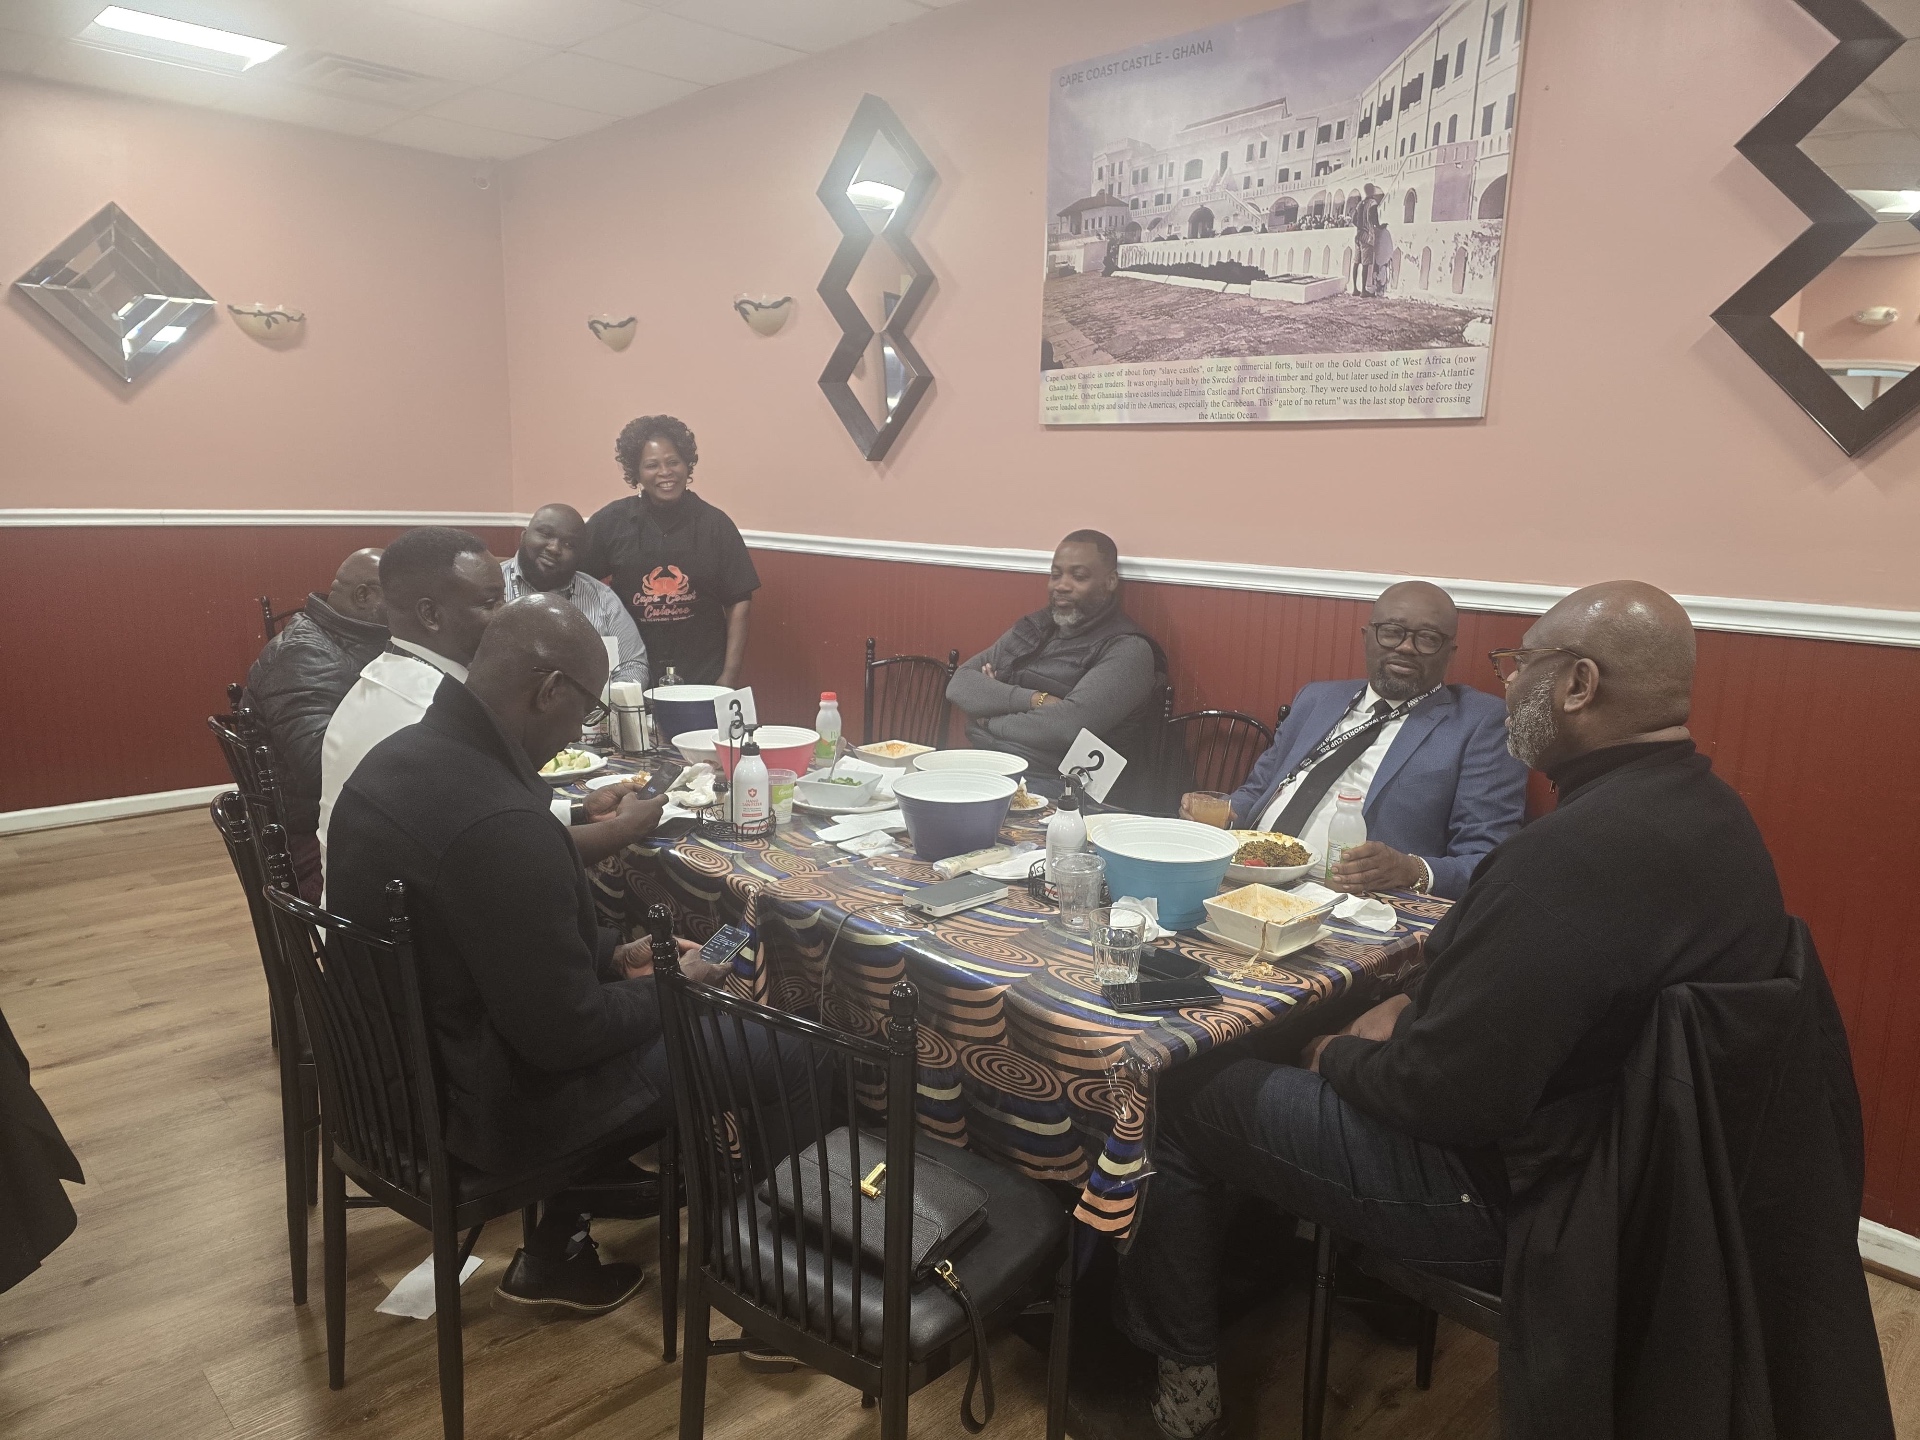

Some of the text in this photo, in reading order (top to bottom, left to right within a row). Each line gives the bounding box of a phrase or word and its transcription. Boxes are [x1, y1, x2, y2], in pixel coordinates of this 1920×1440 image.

[1059, 71, 1084, 88] CAPE
[1086, 62, 1120, 81] COAST
[1121, 51, 1162, 73] CASTLE
[1172, 39, 1214, 61] GHANA
[1045, 375, 1059, 383] Cape
[1078, 372, 1095, 380] Castle
[1142, 368, 1155, 376] forty
[1216, 364, 1231, 373] large
[1234, 361, 1272, 371] commercial
[1274, 361, 1292, 370] forts,
[1296, 360, 1313, 369] built
[1327, 360, 1339, 368] the
[1342, 359, 1361, 368] Gold
[1365, 358, 1386, 367] Coast
[1390, 358, 1400, 366] of
[1402, 357, 1421, 365] West
[1425, 355, 1451, 365] Africa
[1454, 355, 1476, 365] (now
[1146, 378, 1173, 388] originally
[1176, 377, 1190, 385] built
[1191, 377, 1198, 386] by
[1200, 376, 1210, 384] the
[1212, 375, 1235, 383] Swedes
[1237, 374, 1247, 383] for
[1249, 374, 1265, 382] trade
[1267, 374, 1274, 382] in
[1276, 373, 1298, 381] timber
[1300, 372, 1312, 381] and
[1315, 372, 1334, 382] gold,
[1336, 372, 1348, 380] but
[1351, 371, 1368, 380] later
[1370, 371, 1388, 380] used
[1391, 371, 1398, 379] in
[1402, 370, 1414, 379] the
[1416, 368, 1474, 378] trans-Atlantic
[1081, 392, 1096, 400] Other
[1097, 391, 1123, 399] Ghanaian
[1160, 389, 1182, 397] include
[1184, 388, 1205, 396] Elmina
[1207, 388, 1226, 396] Castle
[1228, 387, 1239, 395] and
[1241, 387, 1254, 395] Fort
[1256, 385, 1307, 395] Christiansborg.
[1310, 385, 1327, 394] They
[1350, 384, 1367, 392] used
[1380, 384, 1396, 392] hold
[1399, 383, 1423, 391] slaves
[1426, 382, 1452, 390] before
[1455, 381, 1472, 391] they
[1091, 403, 1105, 412] ships
[1117, 402, 1129, 410] sold
[1130, 402, 1136, 410] in
[1148, 401, 1177, 409] Americas,
[1179, 400, 1208, 410] especially
[1210, 400, 1220, 408] the
[1222, 399, 1256, 407] Caribbean.
[1294, 397, 1303, 405] of
[1315, 396, 1340, 405] return"
[1360, 396, 1371, 404] the
[1373, 396, 1387, 404] last
[1389, 398, 1405, 406] stop
[1408, 395, 1434, 404] before
[1436, 394, 1470, 404] crossing
[1199, 411, 1259, 420] the Atlantic Ocean.
[632, 592, 660, 606] Cape
[644, 605, 690, 618] Cuisine
[729, 699, 744, 729] 3
[1342, 724, 1366, 741] WORLD
[1330, 737, 1344, 749] CUP
